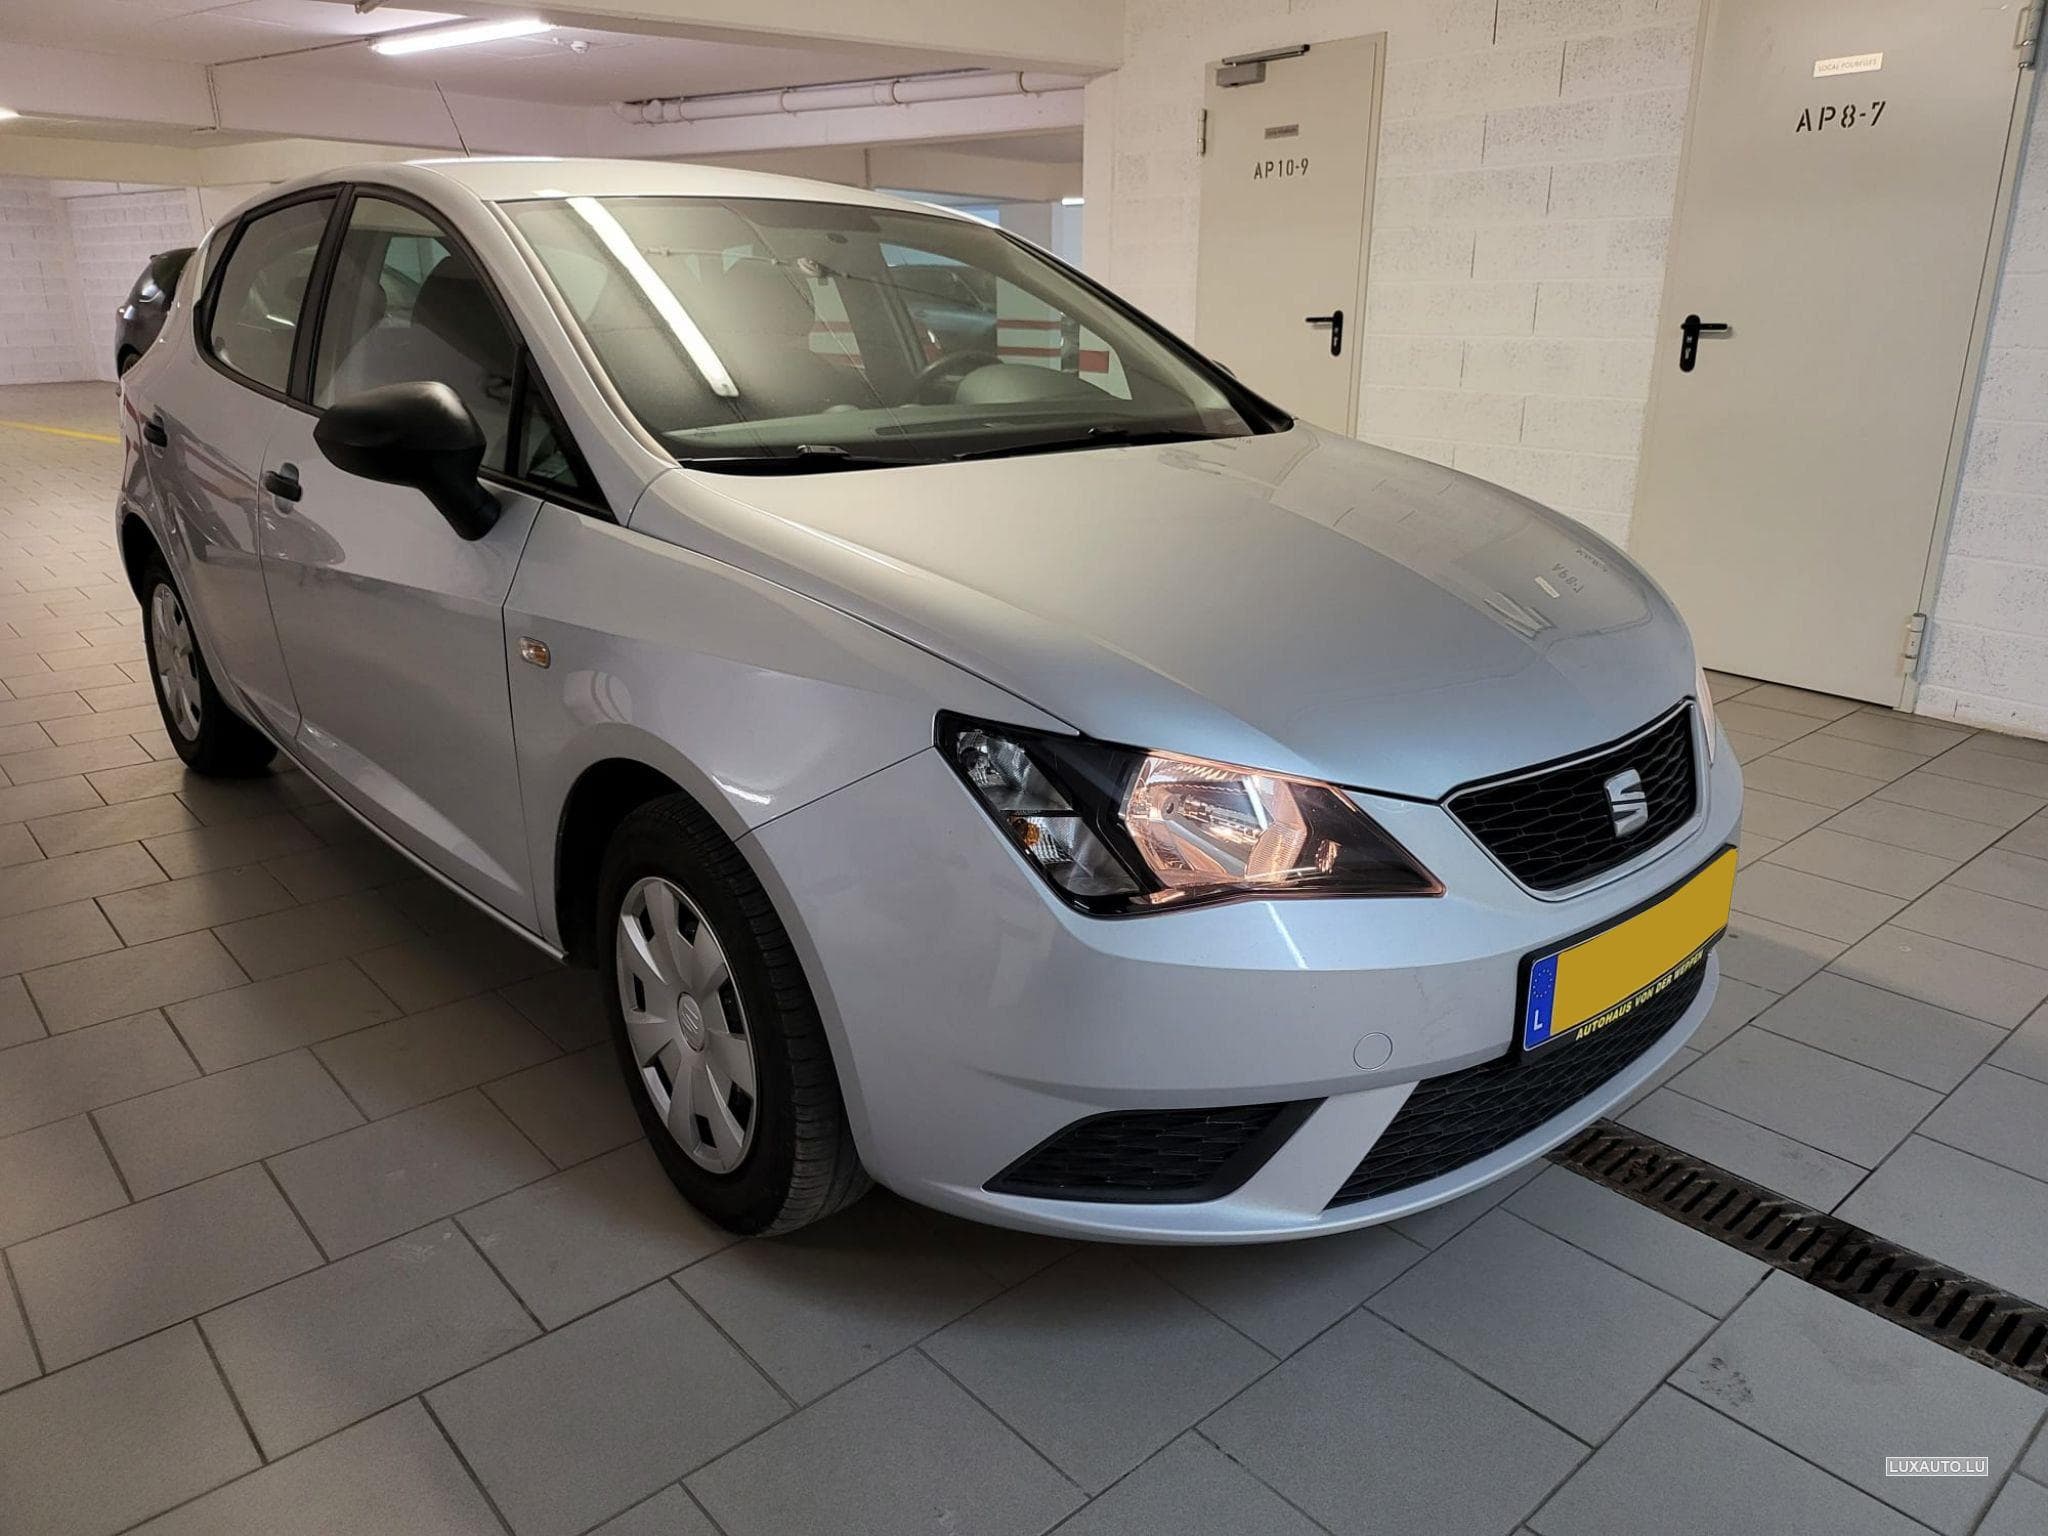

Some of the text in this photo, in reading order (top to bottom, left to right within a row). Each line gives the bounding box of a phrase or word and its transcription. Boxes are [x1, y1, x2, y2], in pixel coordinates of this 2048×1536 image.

[1796, 101, 1886, 132] AP8-7
[1254, 158, 1309, 179] AP10-9
[1533, 1009, 1544, 1031] L
[1575, 1001, 1633, 1041] AUTOHAUS
[1635, 986, 1655, 1007] VON
[1655, 974, 1672, 994] DER
